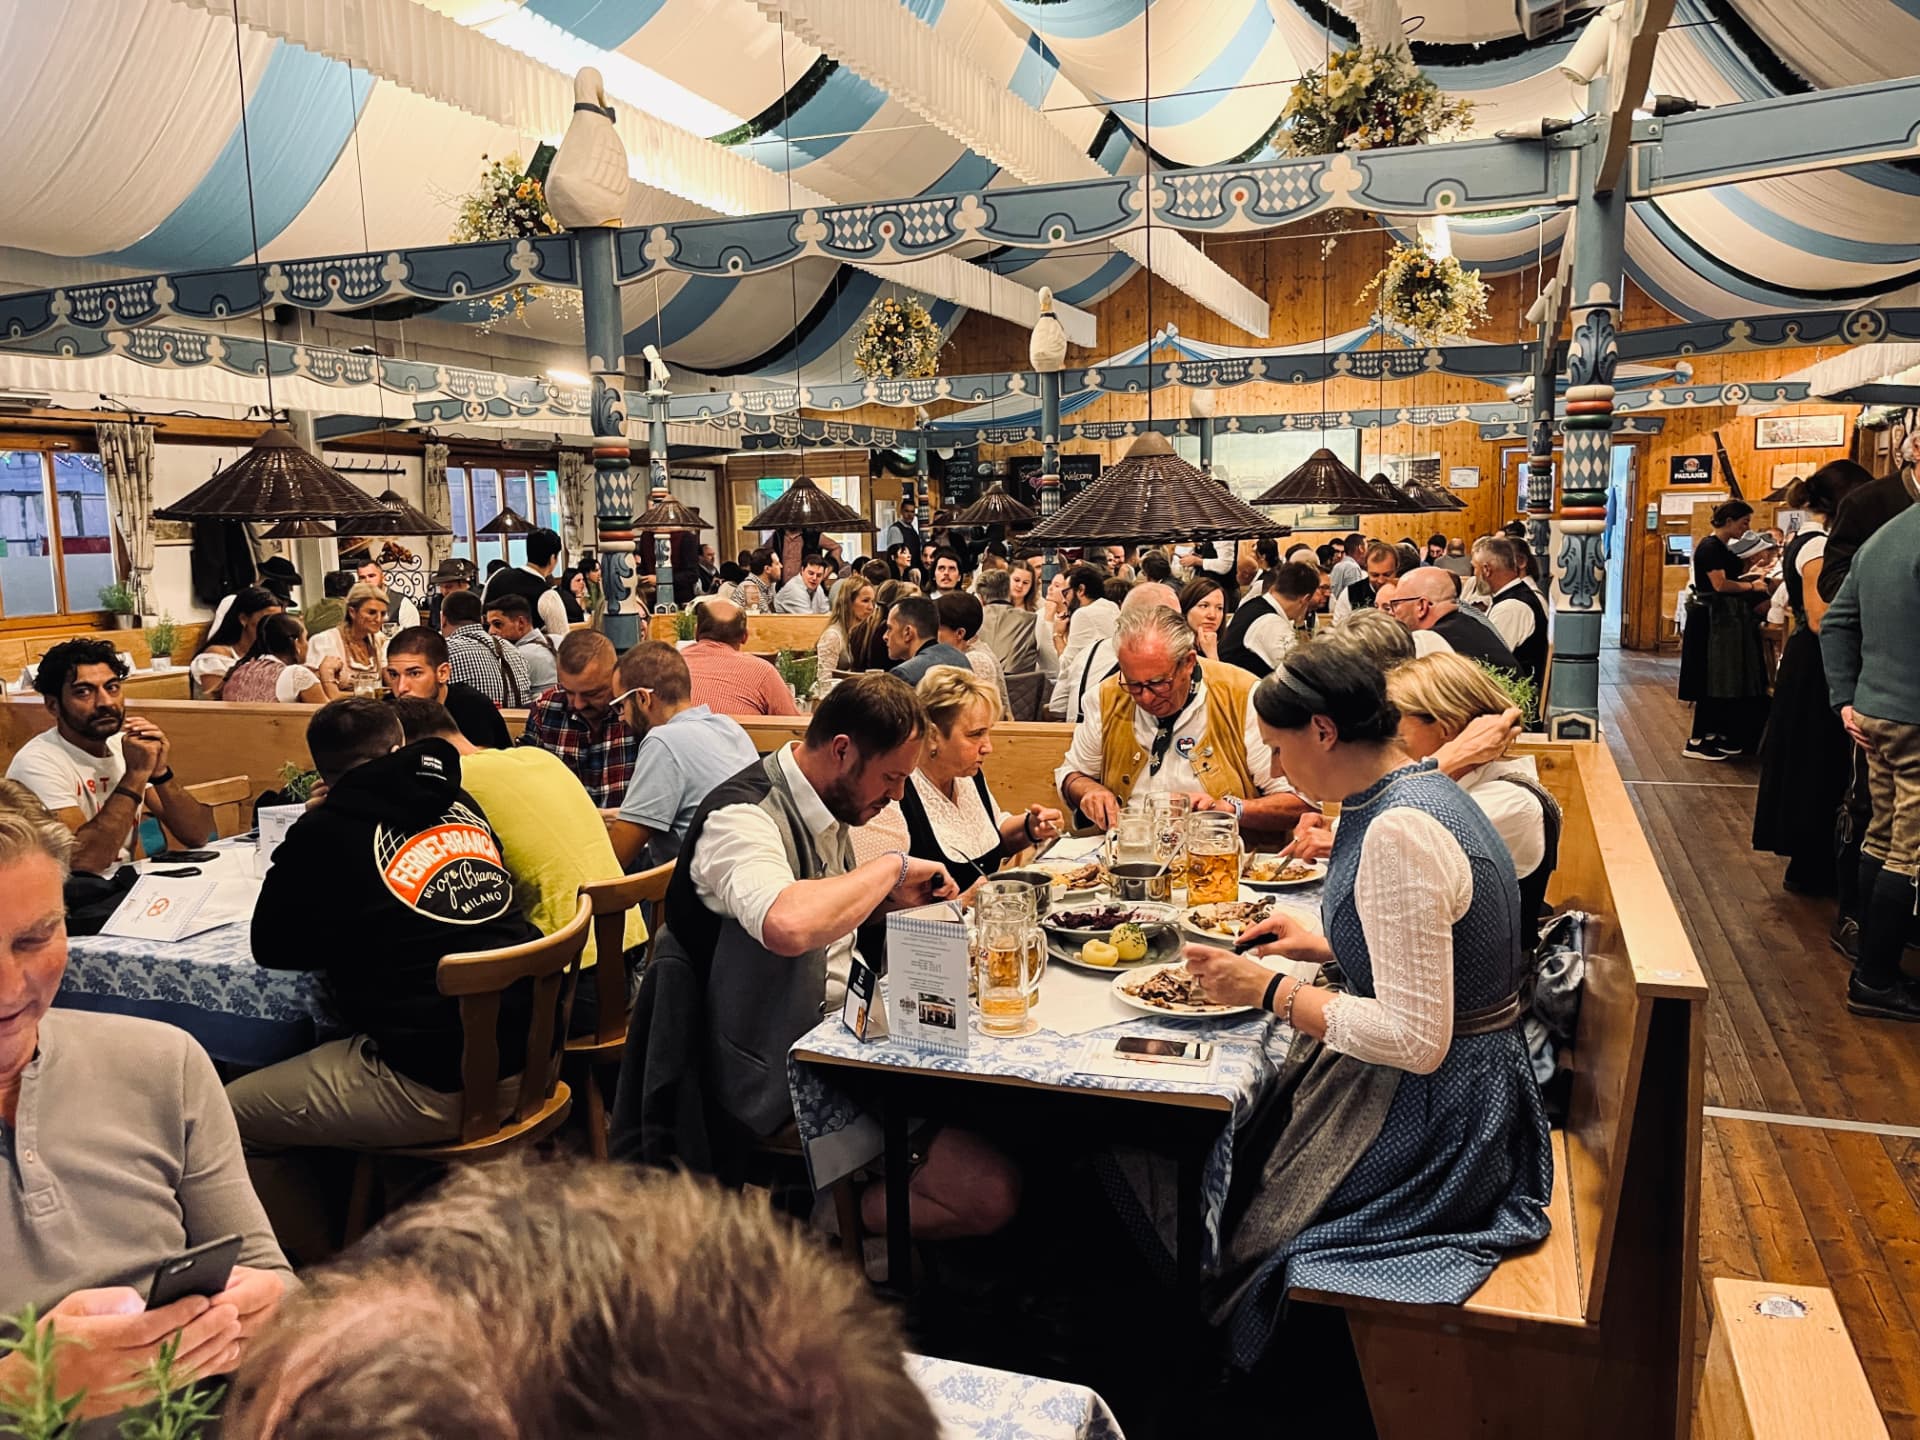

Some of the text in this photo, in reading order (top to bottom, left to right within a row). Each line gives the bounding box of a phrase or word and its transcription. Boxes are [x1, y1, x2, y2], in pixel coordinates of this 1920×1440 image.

[1063, 471, 1093, 481] Welcome
[1674, 472, 1708, 480] PAULANER
[423, 885, 436, 899] DEI
[459, 861, 504, 889] Branca
[461, 891, 502, 914] MILANO
